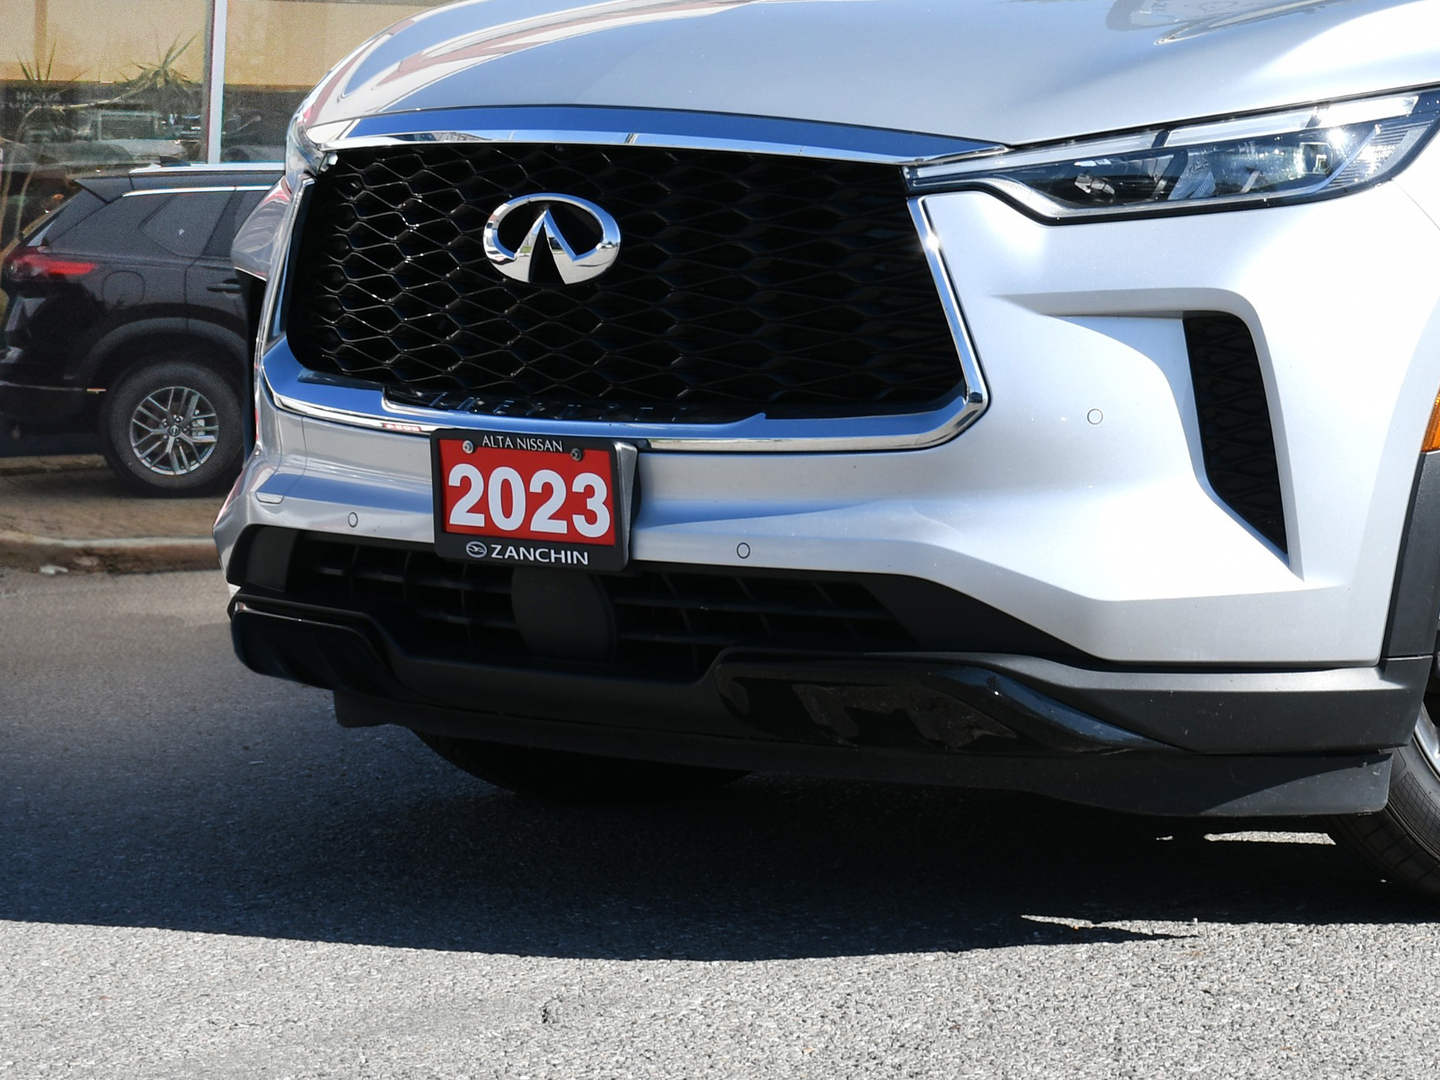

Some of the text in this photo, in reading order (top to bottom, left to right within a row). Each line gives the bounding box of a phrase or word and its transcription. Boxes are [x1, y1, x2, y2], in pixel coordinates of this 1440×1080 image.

[482, 435, 564, 453] ALTA NISSAN
[448, 462, 611, 539] 2023
[490, 543, 590, 566] ZANCHIN
